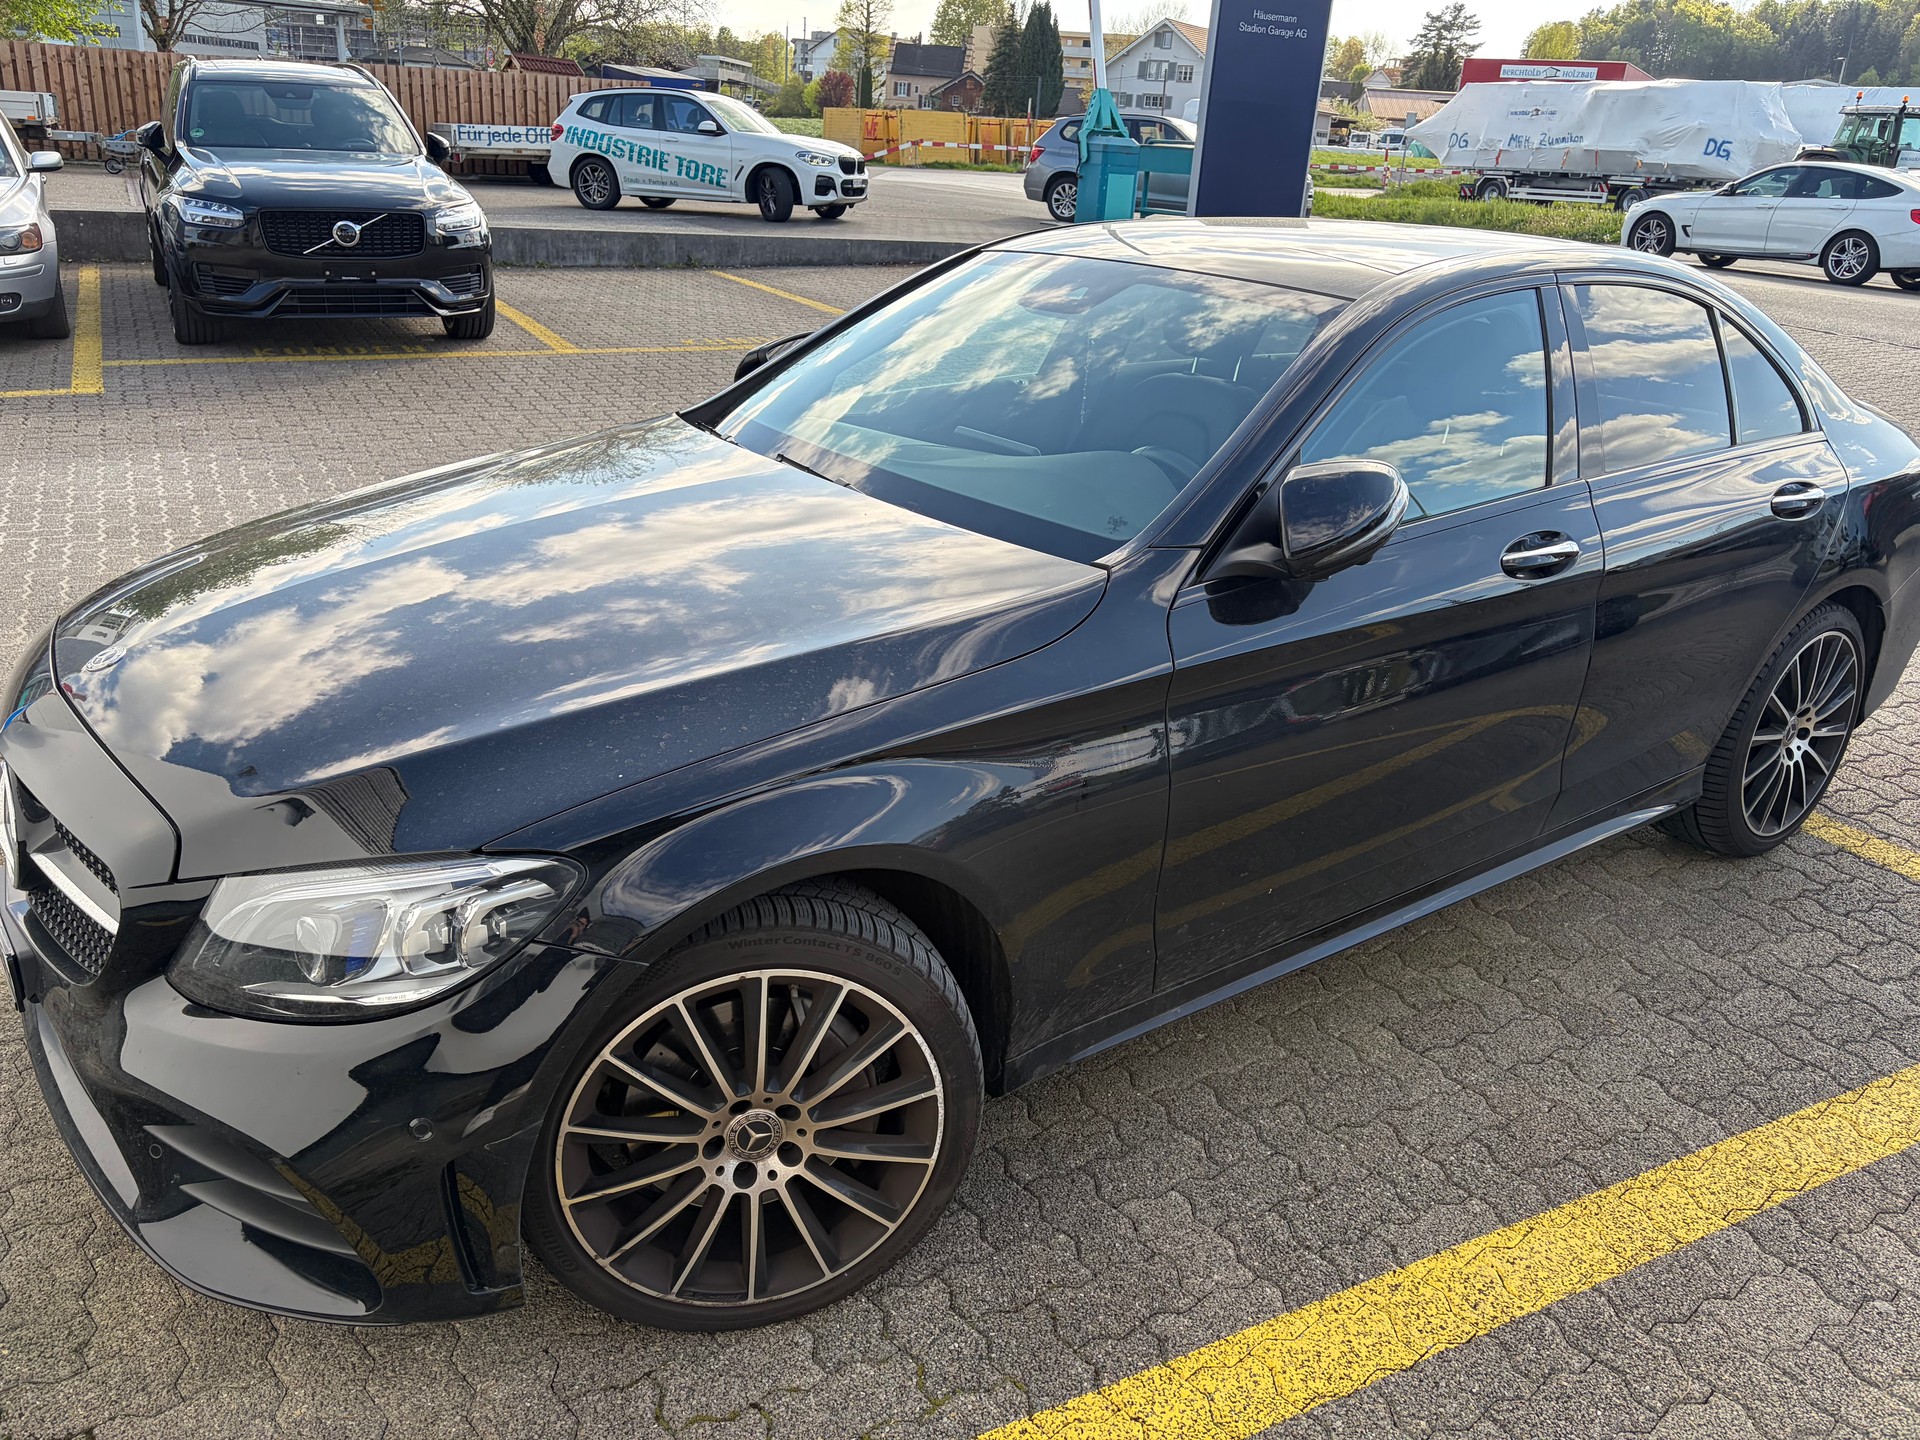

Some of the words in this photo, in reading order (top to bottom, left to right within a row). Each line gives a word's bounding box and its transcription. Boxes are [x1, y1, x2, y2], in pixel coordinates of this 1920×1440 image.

[1253, 9, 1298, 23] Häusermann
[1239, 21, 1267, 34] Stadion
[1267, 25, 1294, 39] Garage
[1294, 28, 1308, 39] AG
[457, 125, 484, 141] Für
[487, 126, 521, 146] jede
[1448, 132, 1469, 149] DG
[564, 125, 671, 173] INDUSTRIE
[675, 155, 729, 188] TORE
[1703, 138, 1733, 161] DG
[844, 944, 862, 957] TS
[865, 951, 892, 970] 860
[892, 968, 902, 977] S
[729, 1132, 737, 1149] BENZ
[768, 1117, 781, 1149] MERCEDES
